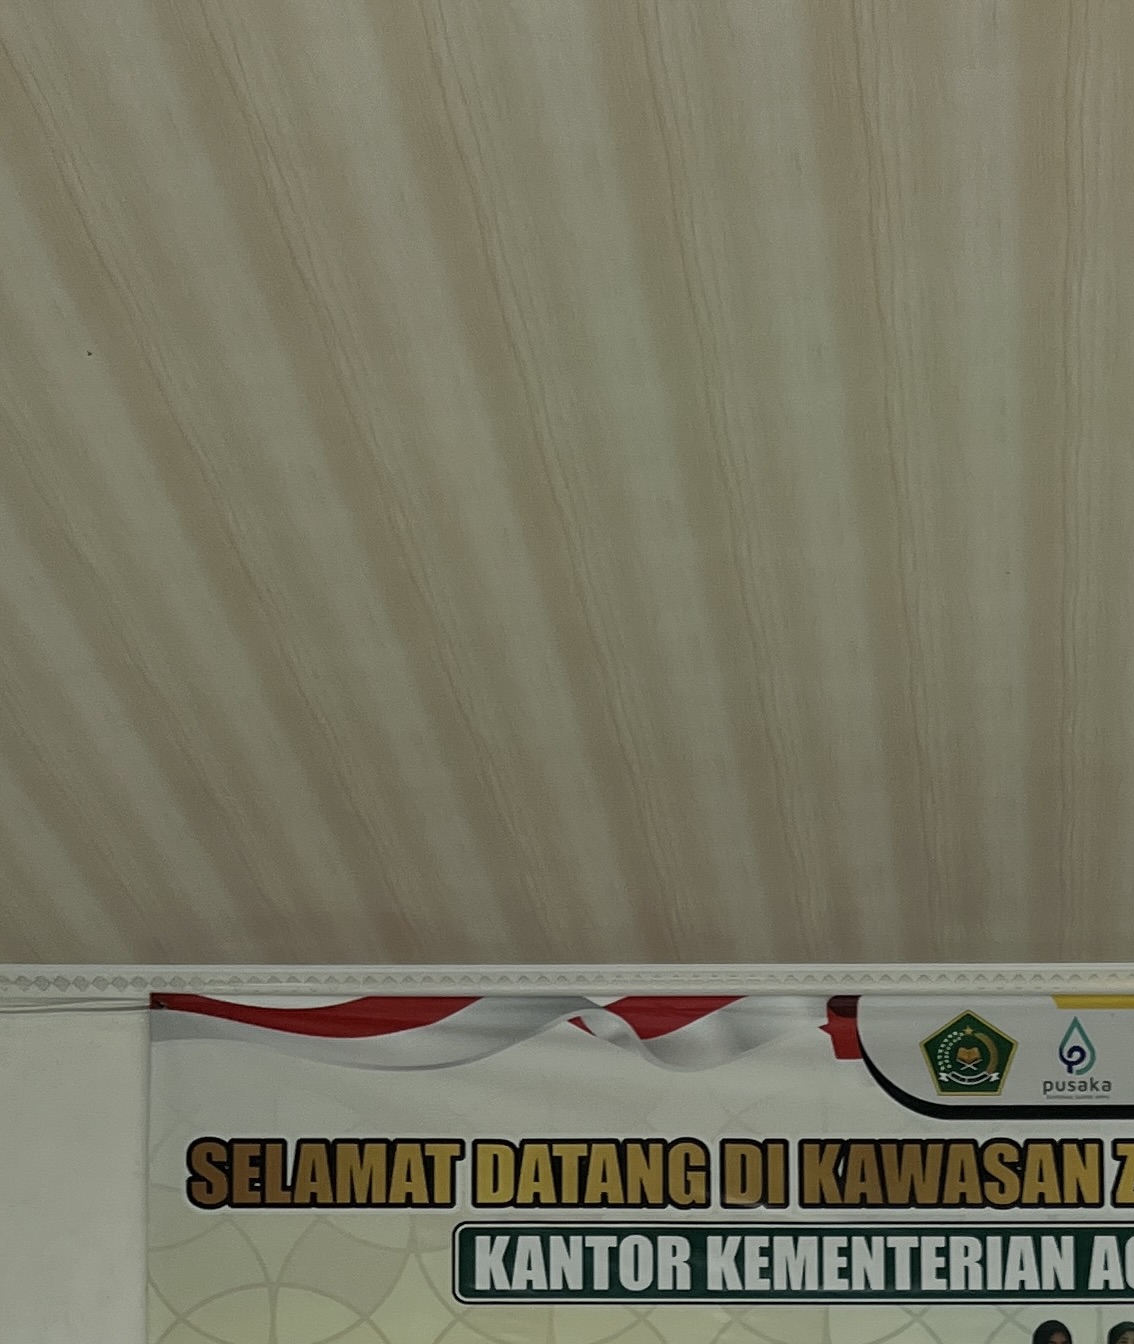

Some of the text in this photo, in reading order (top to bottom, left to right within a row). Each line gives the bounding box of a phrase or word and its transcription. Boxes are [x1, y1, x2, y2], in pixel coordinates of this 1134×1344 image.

[1042, 1077, 1112, 1095] pusaka
[188, 1141, 463, 1207] SELAMAT
[475, 1140, 708, 1207] DATANG
[723, 1141, 786, 1207] DI
[801, 1140, 1101, 1207] KAWASAN
[474, 1234, 692, 1292] KANTOR
[706, 1234, 1075, 1291] KEMENTERIAN
